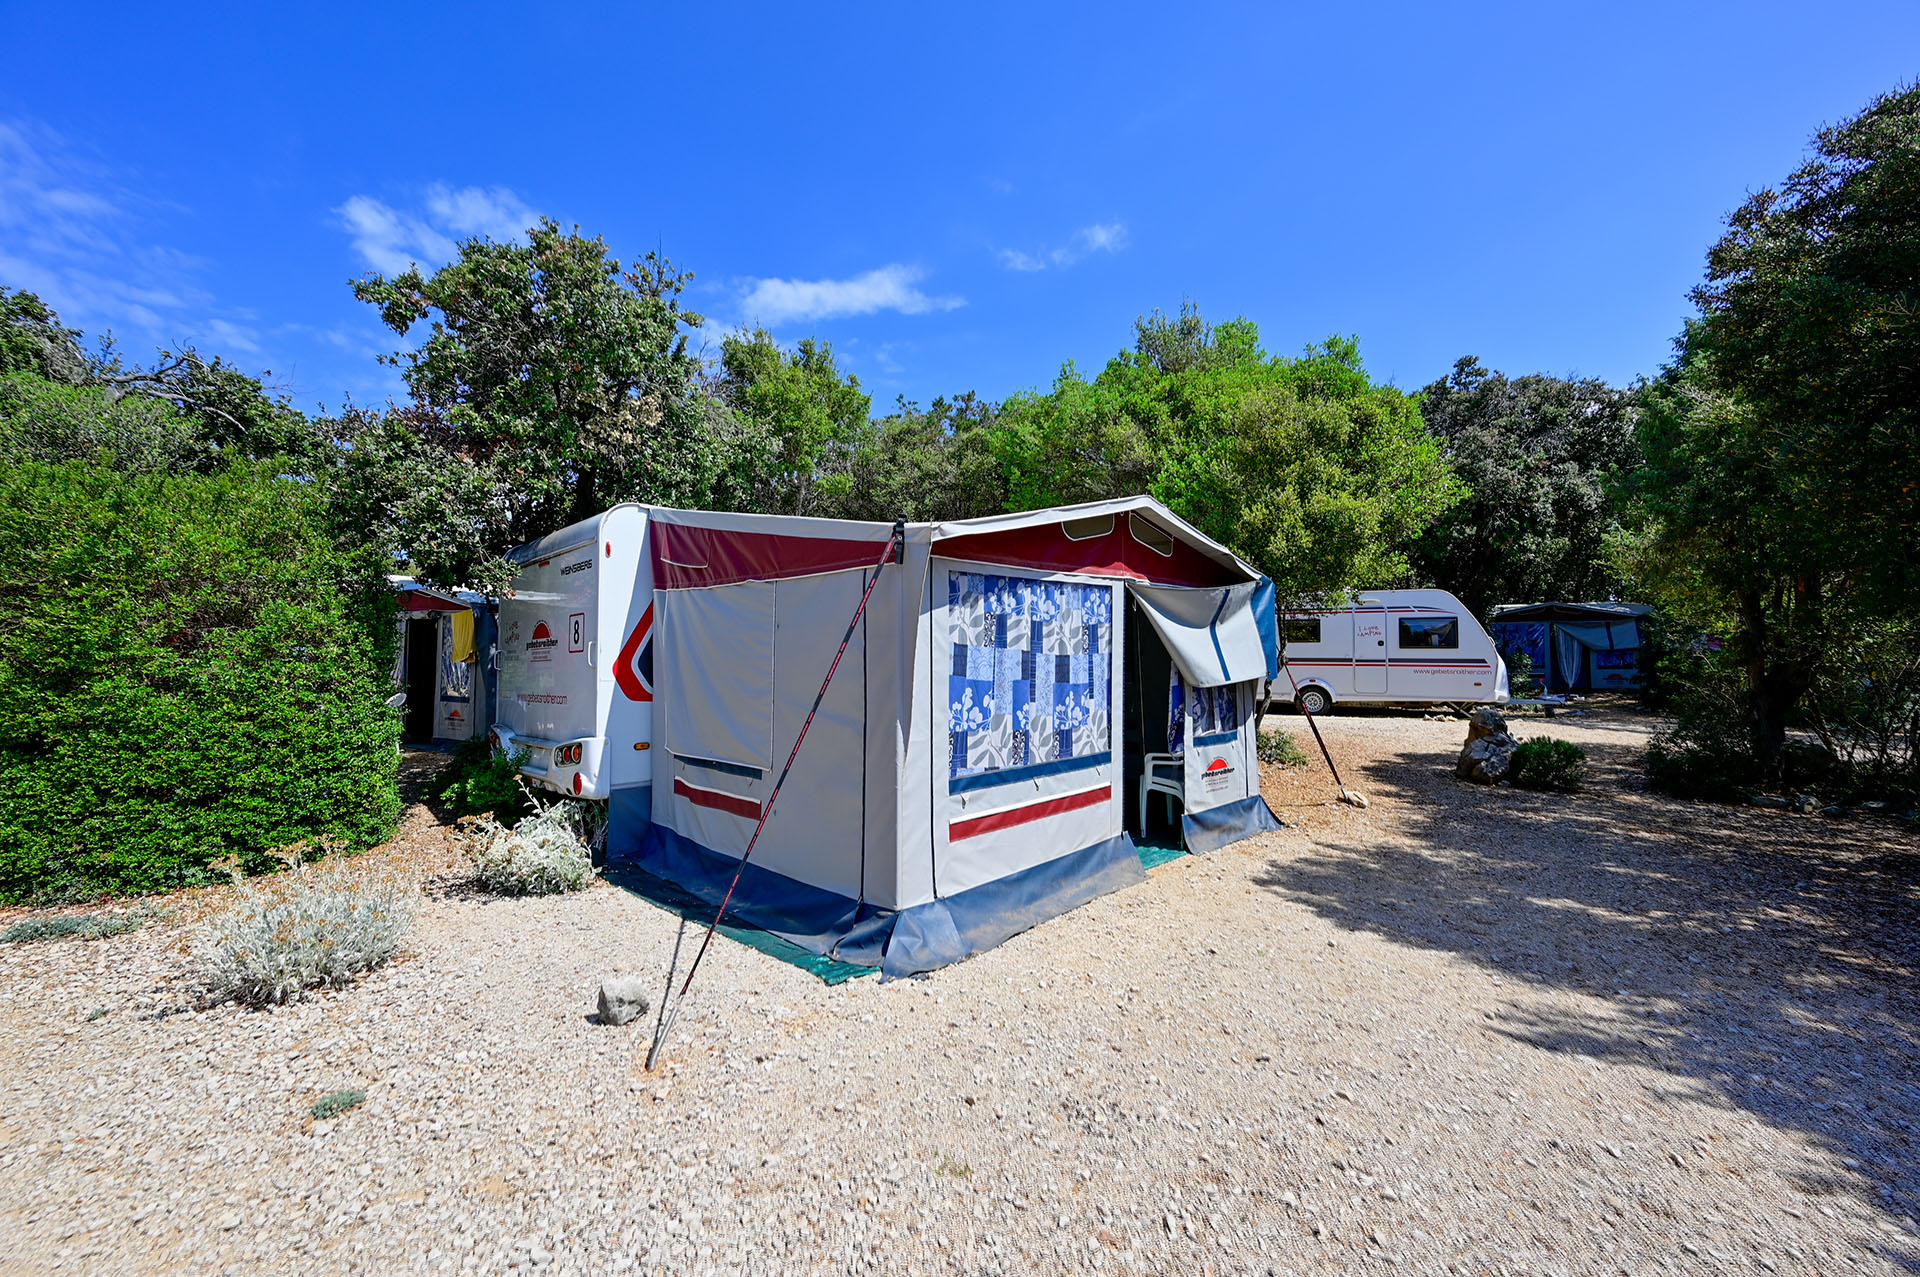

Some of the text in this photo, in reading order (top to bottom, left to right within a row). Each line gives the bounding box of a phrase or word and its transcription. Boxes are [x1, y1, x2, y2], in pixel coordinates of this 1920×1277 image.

[561, 559, 593, 576] WEINSBERG
[573, 620, 580, 645] 8
[1413, 668, 1493, 676] www.gebetsroither.com
